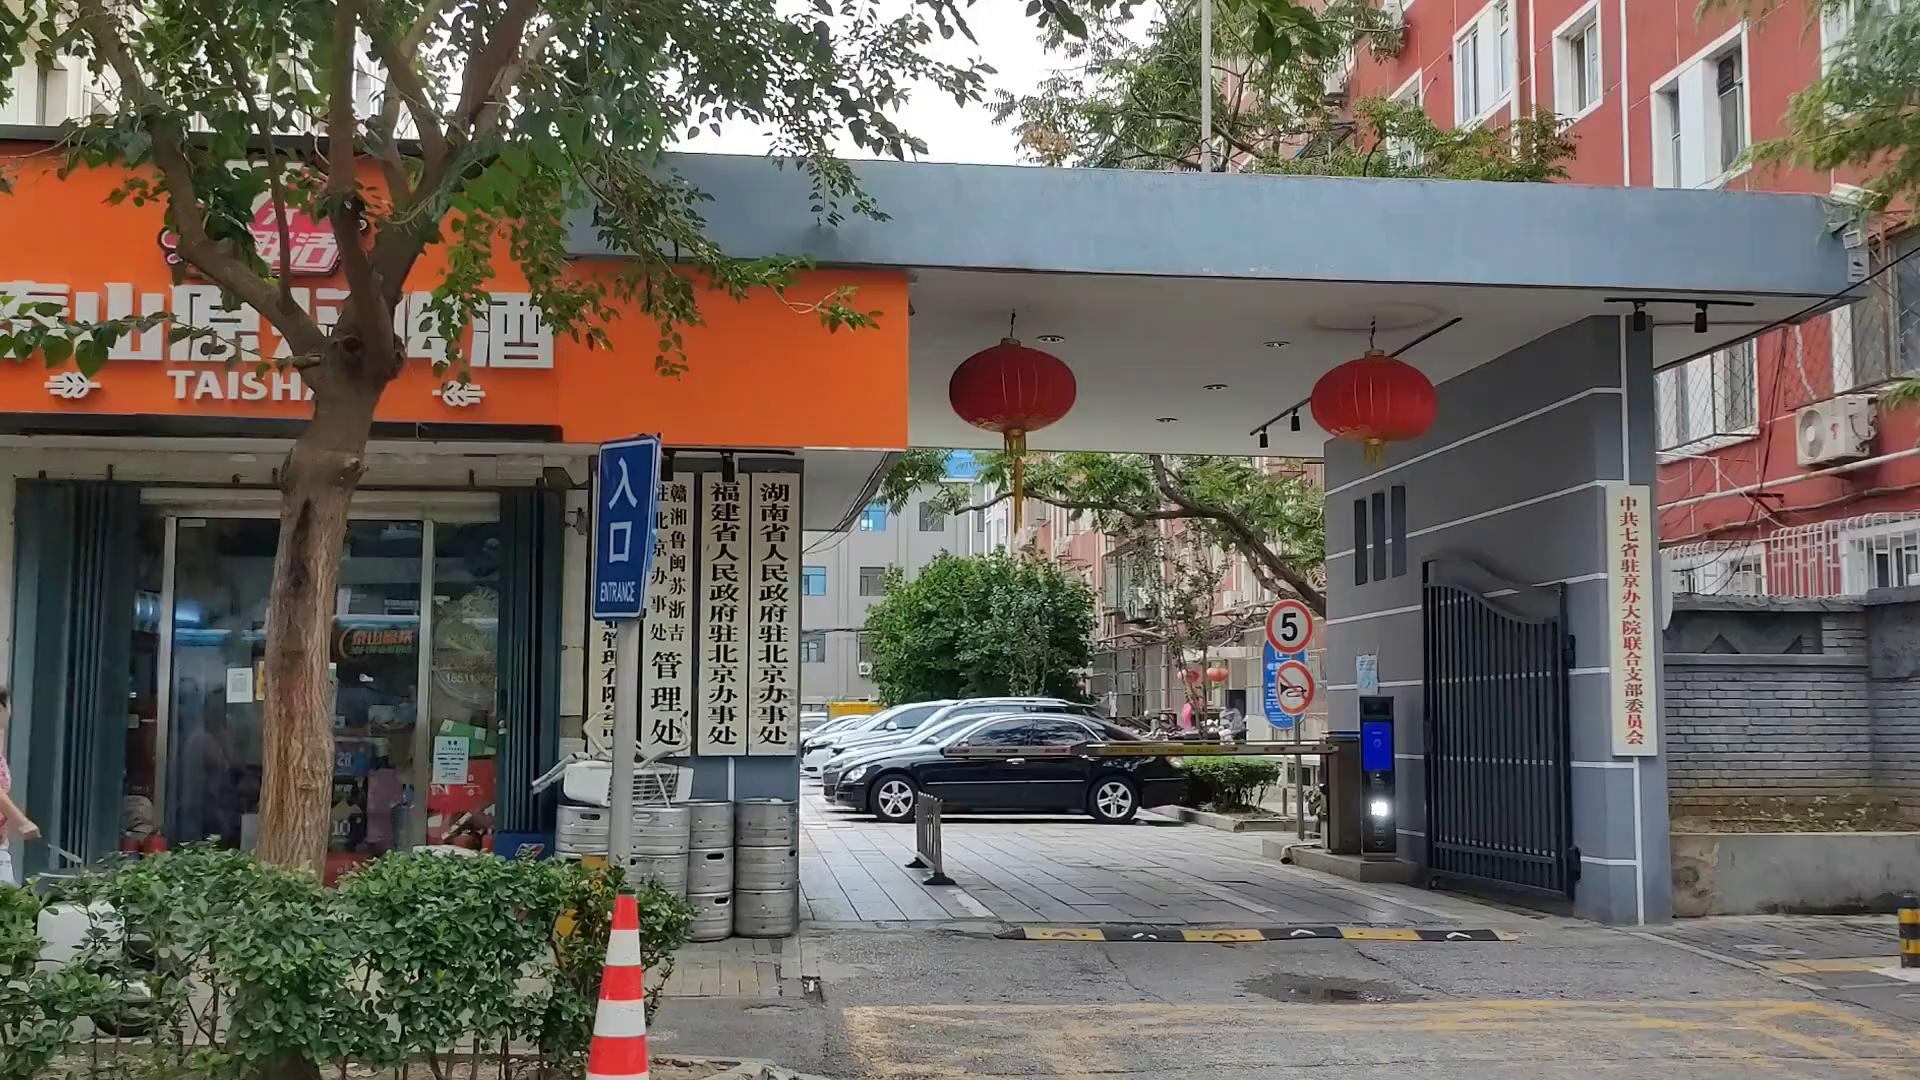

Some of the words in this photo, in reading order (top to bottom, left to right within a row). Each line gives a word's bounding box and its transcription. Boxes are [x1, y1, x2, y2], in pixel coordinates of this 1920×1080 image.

[608, 457, 638, 564] 入口
[669, 483, 688, 642] 赣湘鲁闽苏浙吉
[600, 581, 636, 603] ENTRANCE
[708, 481, 739, 745] 福建省人民政府驻北京办事处
[758, 483, 789, 745] 湖南省人民政府驻北京办事处
[1281, 612, 1298, 642] 5
[1619, 495, 1644, 745] 中共七省驻京办大院联合支部委员会
[650, 651, 683, 746] 管理处
